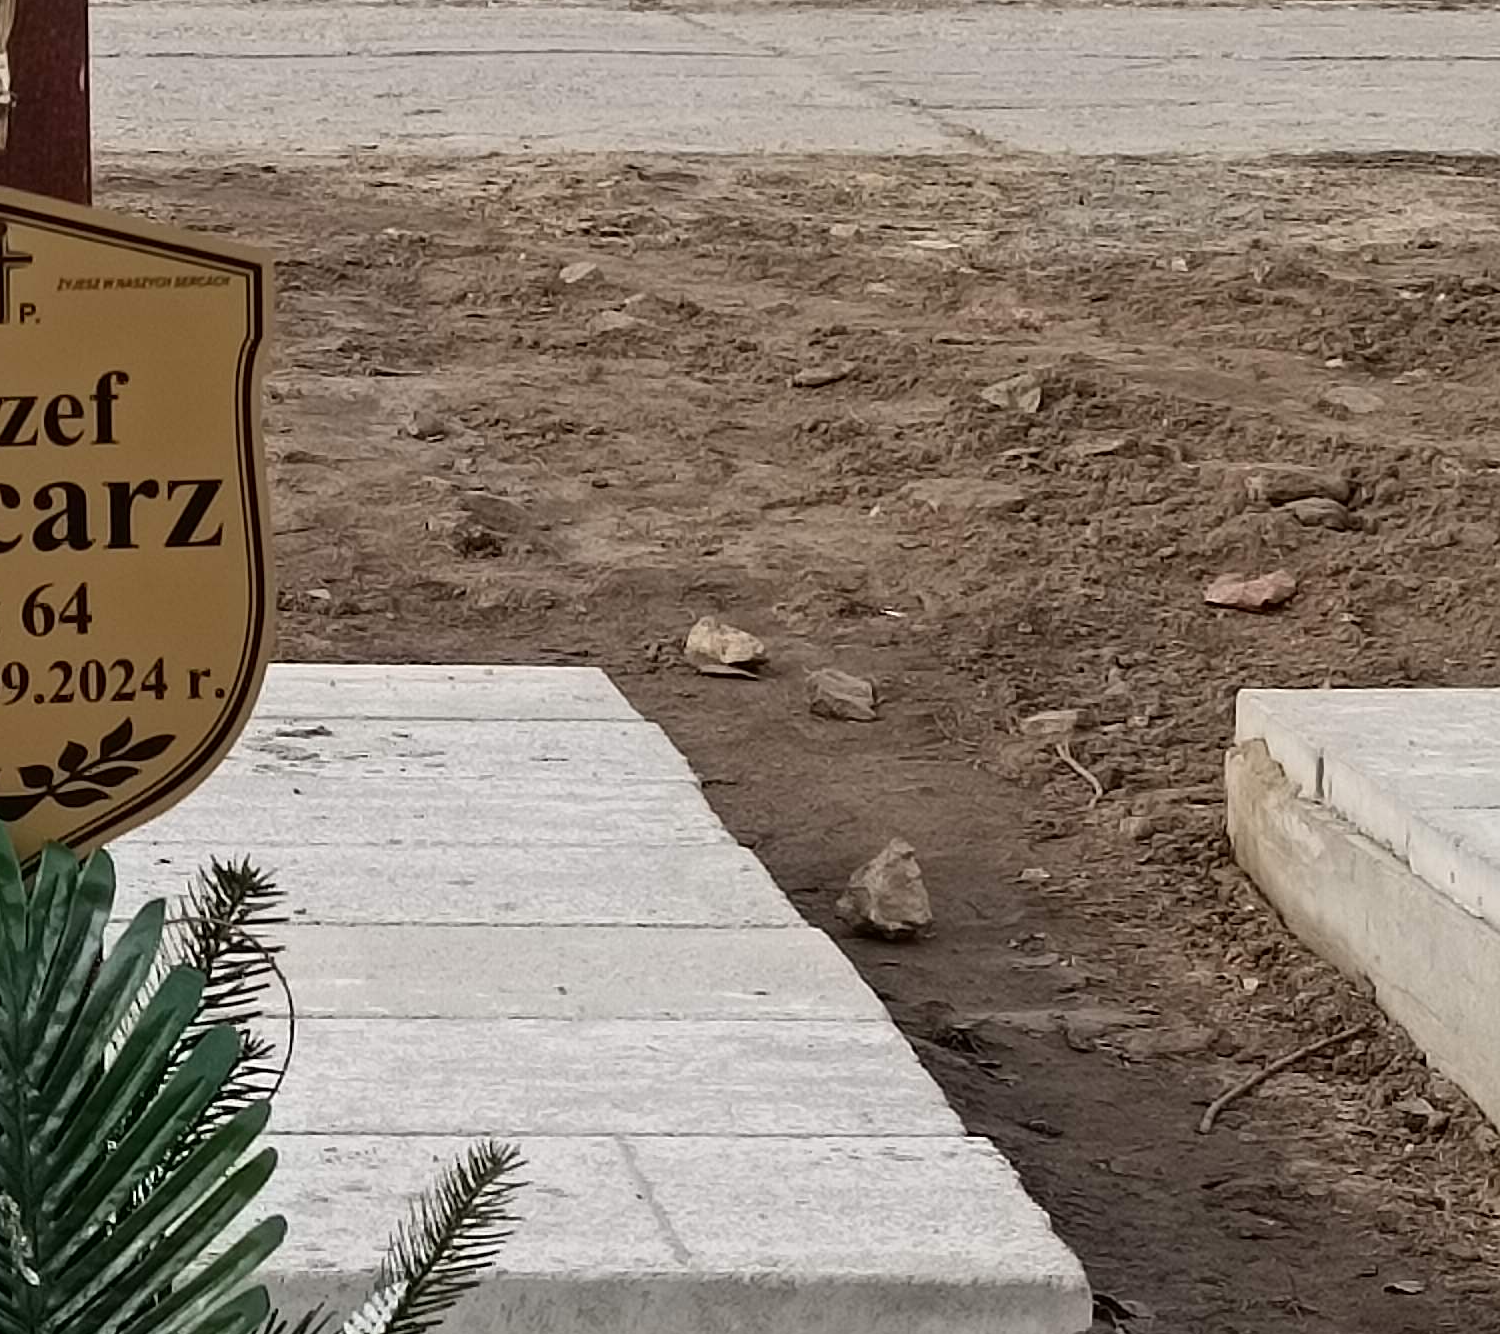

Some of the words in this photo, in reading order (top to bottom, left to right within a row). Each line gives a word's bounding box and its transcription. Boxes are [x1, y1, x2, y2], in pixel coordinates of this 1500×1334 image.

[103, 276, 115, 290] W
[19, 302, 41, 324] P.
[21, 582, 93, 638] 64
[186, 669, 227, 701] r.
